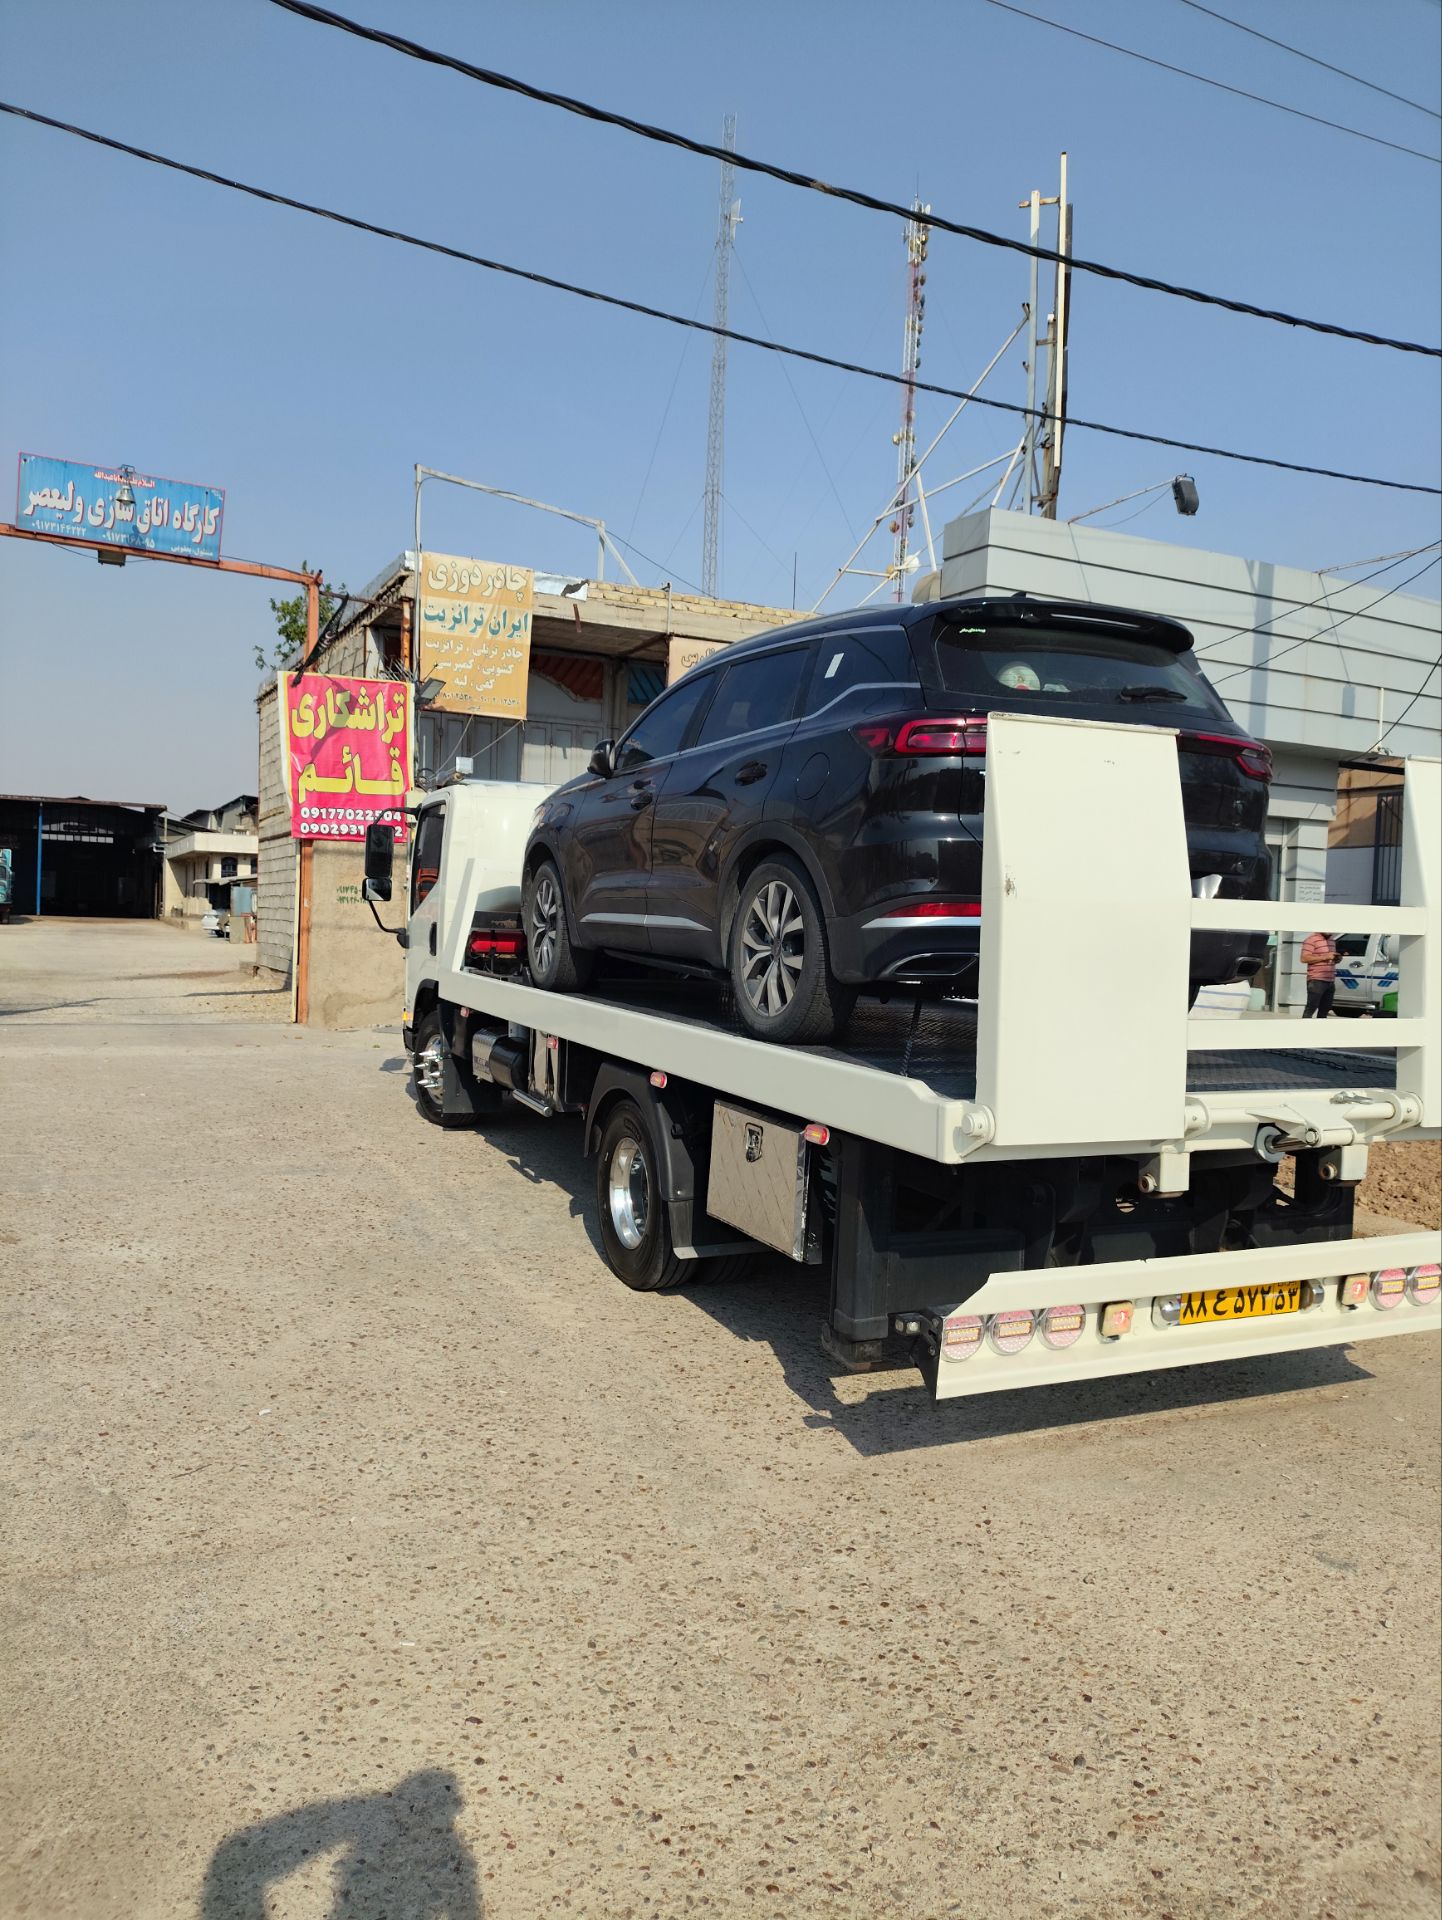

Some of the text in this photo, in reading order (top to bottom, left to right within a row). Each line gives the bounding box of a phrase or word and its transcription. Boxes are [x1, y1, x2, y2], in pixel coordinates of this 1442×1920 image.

[24, 480, 220, 543] کارگاه اتاق سازی ولیعصر
[428, 561, 527, 602] چادر دوزی
[424, 603, 529, 638] ایران ترانزیت
[291, 686, 405, 744] تراشکاری
[298, 746, 405, 804] قائم
[300, 822, 403, 837] 09029312
